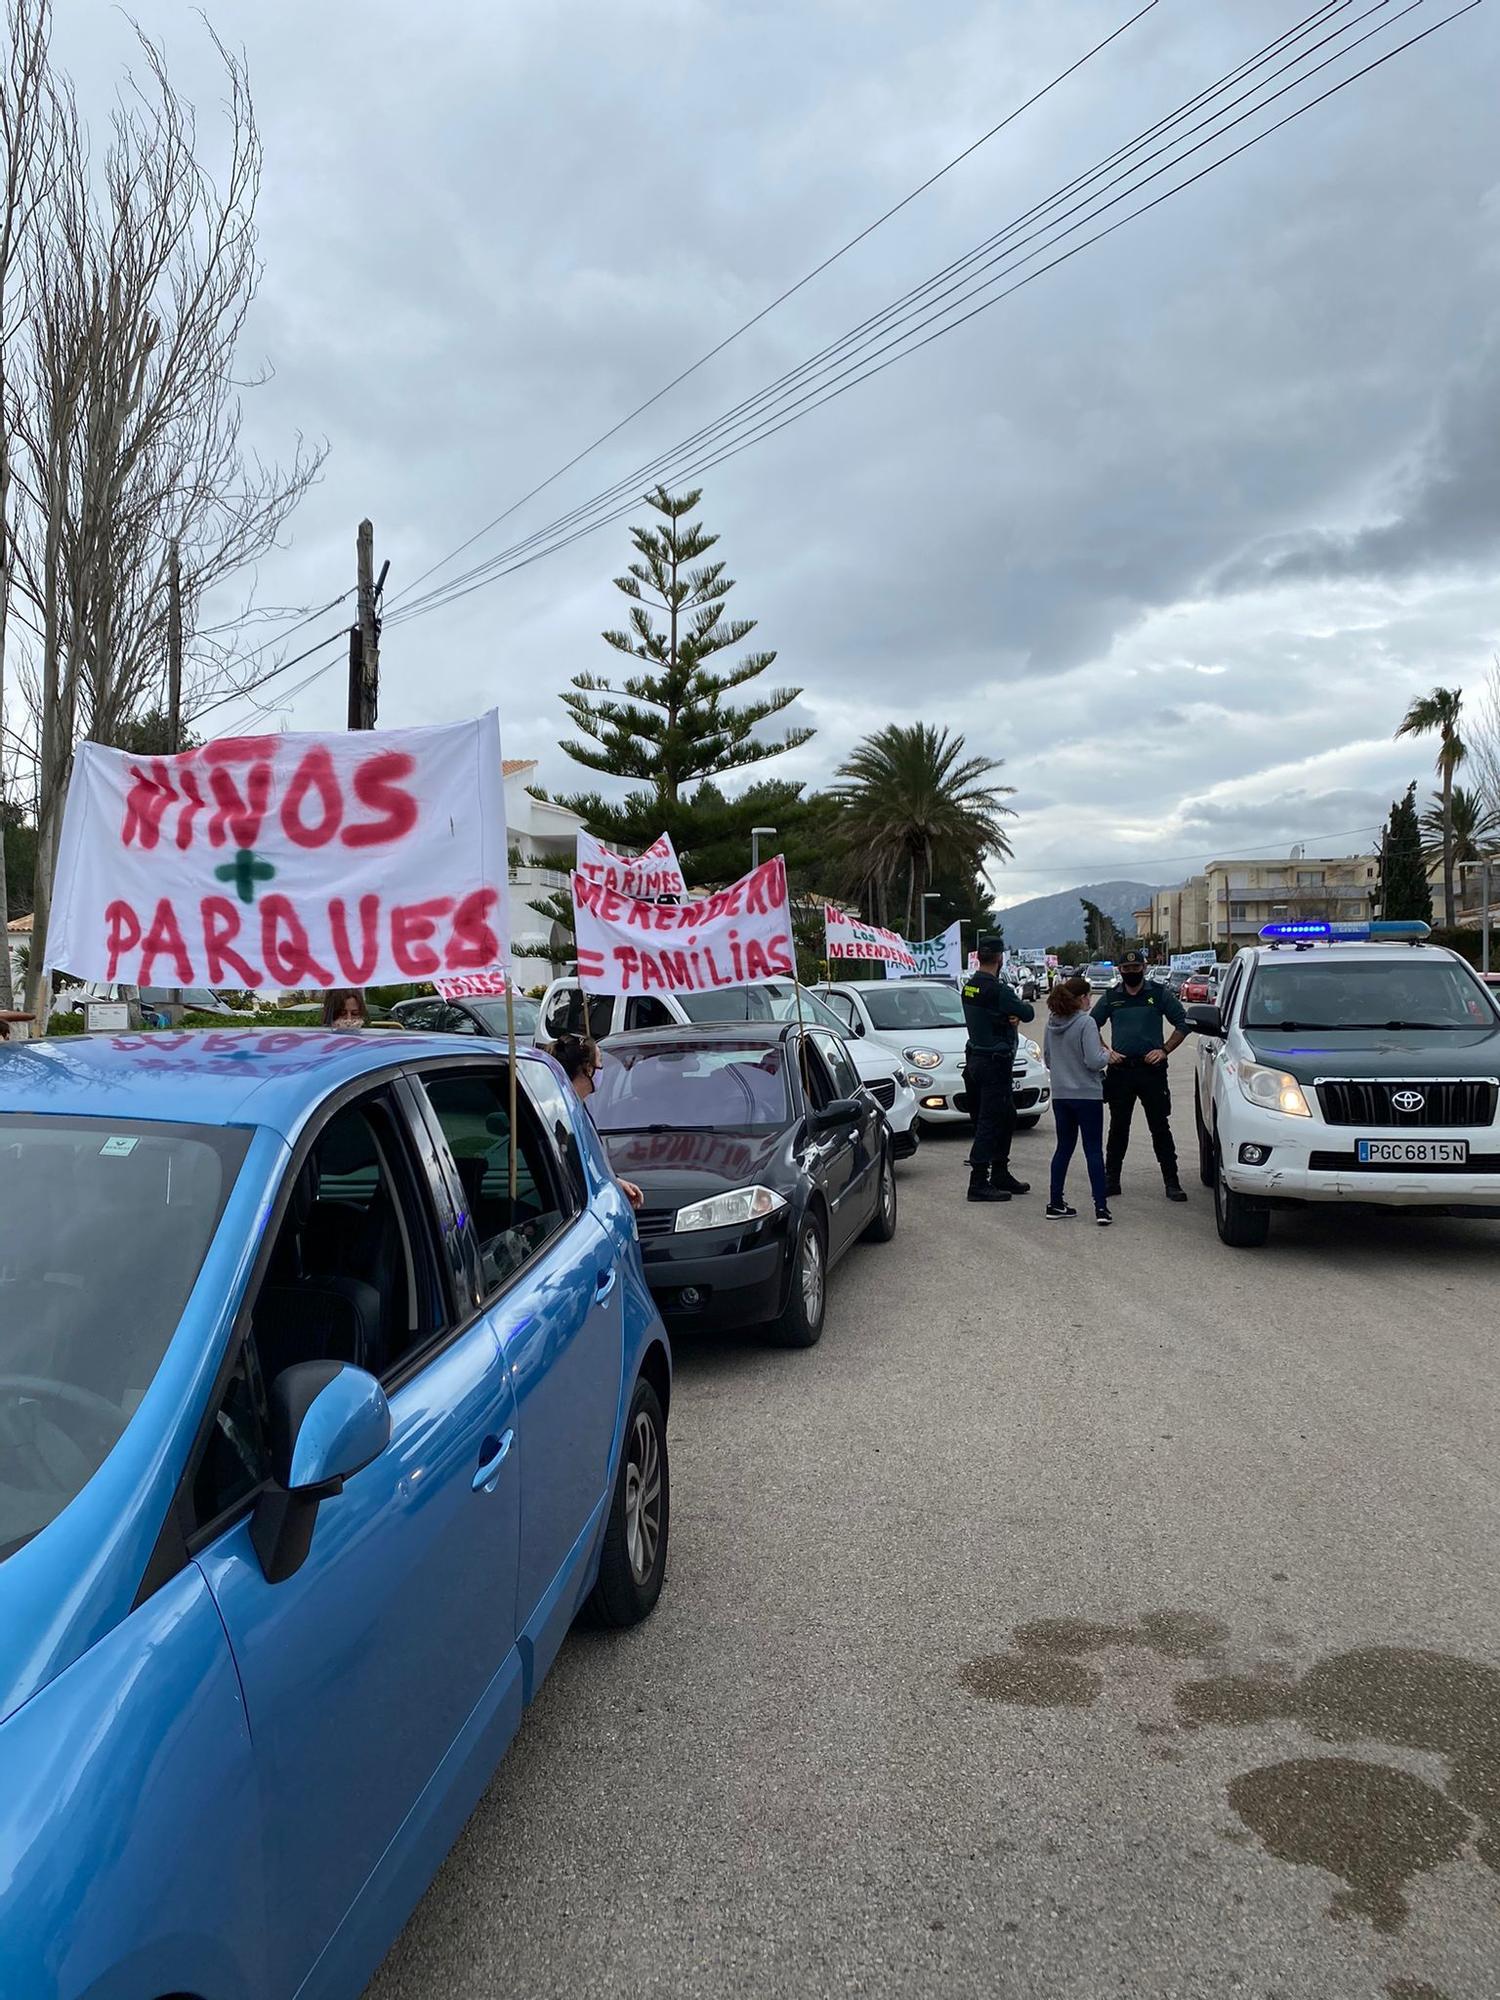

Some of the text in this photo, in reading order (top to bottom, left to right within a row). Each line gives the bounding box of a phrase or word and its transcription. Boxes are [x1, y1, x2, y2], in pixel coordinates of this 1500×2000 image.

[121, 736, 418, 850] NIÑOS
[105, 888, 499, 988] PARQUES
[852, 929, 876, 942] LOS
